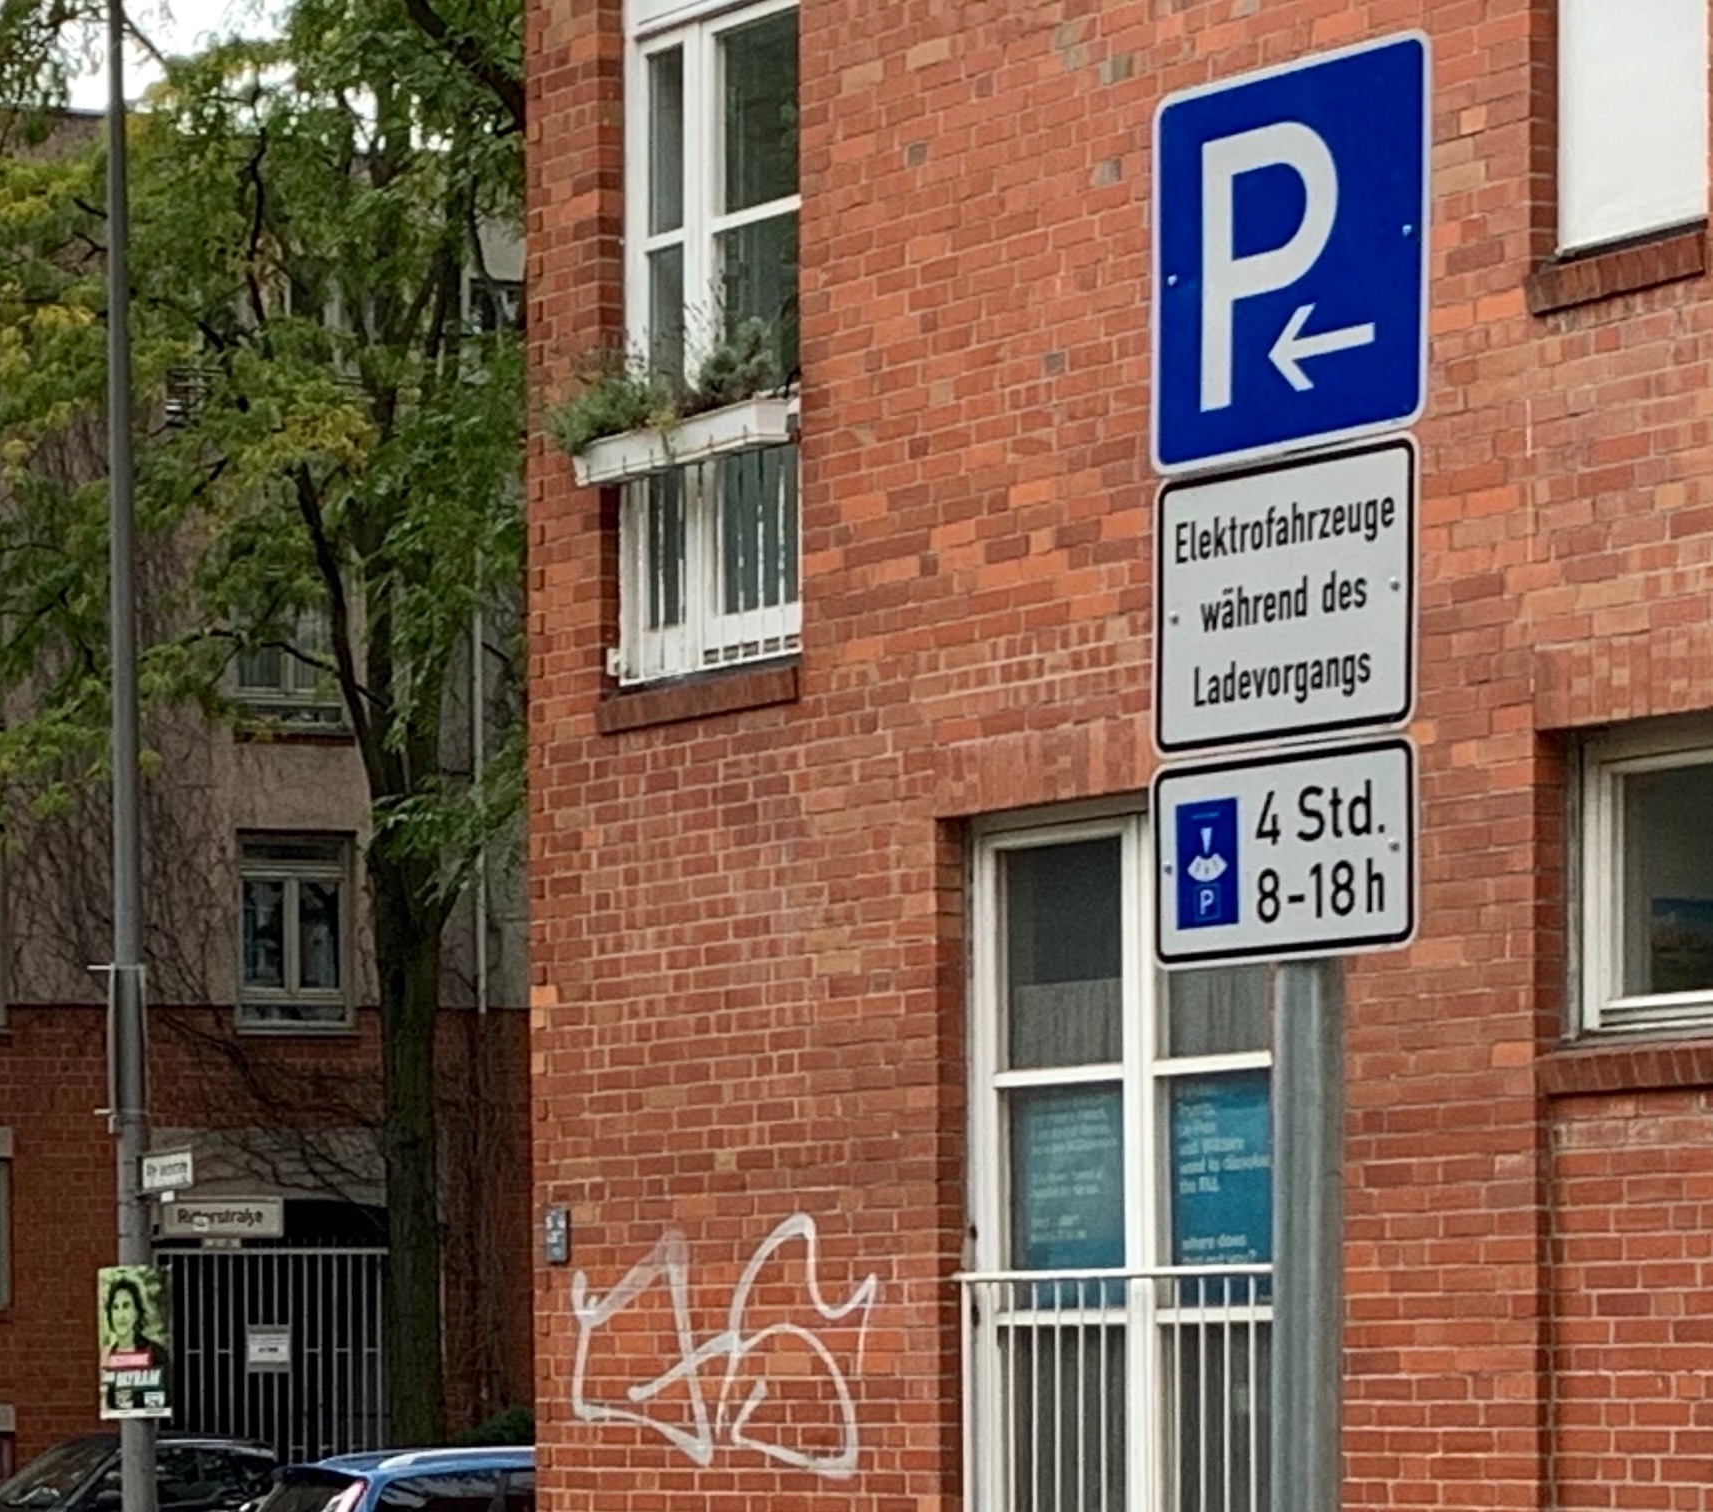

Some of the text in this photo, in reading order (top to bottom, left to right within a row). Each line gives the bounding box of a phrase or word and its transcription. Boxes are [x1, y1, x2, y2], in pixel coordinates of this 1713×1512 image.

[1200, 121, 1338, 413] P
[1175, 496, 1395, 565] Elektrofahrzeuge
[1200, 570, 1368, 632] während des
[1193, 652, 1372, 707] Ladevorgangs
[1255, 779, 1386, 846] 4 Std.
[1200, 889, 1215, 915] P
